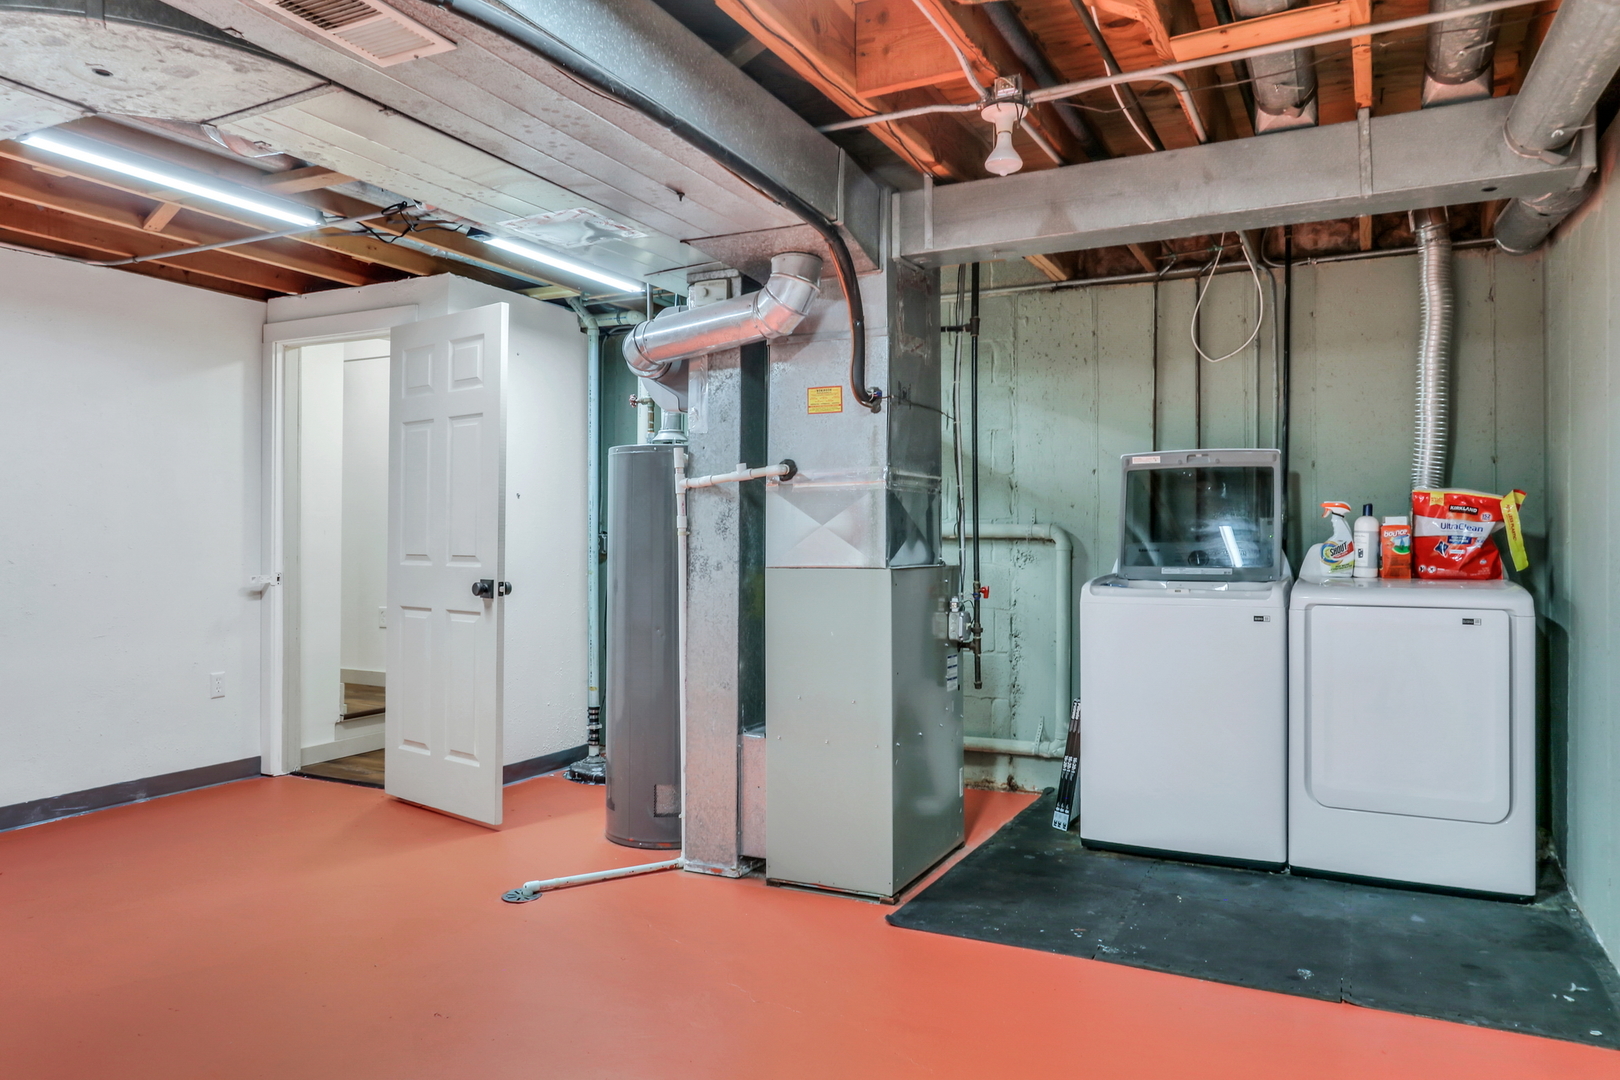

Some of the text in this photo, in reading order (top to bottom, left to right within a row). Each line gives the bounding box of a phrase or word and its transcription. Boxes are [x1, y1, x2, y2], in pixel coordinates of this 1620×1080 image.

[1450, 505, 1478, 513] KIRKLAND
[1440, 522, 1484, 532] UltraClean
[1330, 541, 1347, 556] SHOUT
